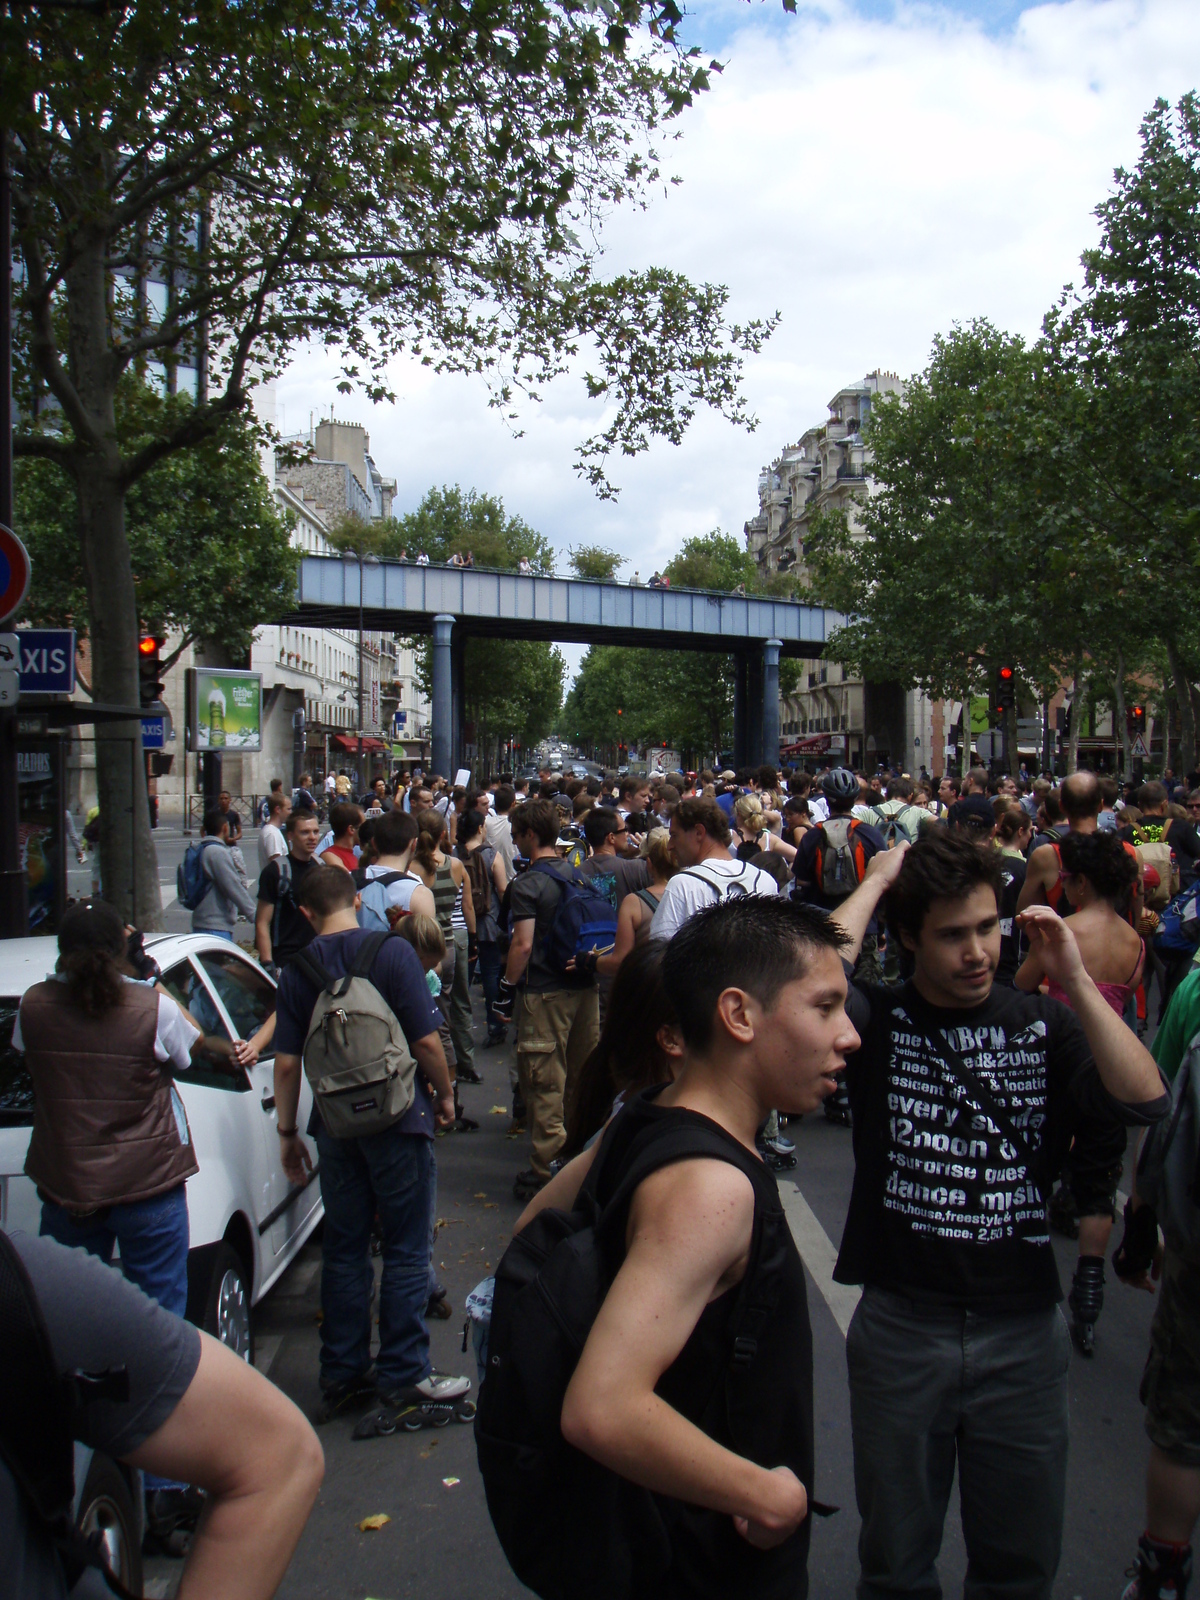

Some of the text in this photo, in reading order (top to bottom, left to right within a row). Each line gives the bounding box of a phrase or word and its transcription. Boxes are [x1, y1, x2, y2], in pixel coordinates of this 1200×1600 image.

[887, 1092, 960, 1128] every
[886, 1170, 967, 1206] dance
[985, 1165, 1027, 1184] gues
[911, 1222, 973, 1239] entrance:
[1006, 1225, 1013, 1237] $
